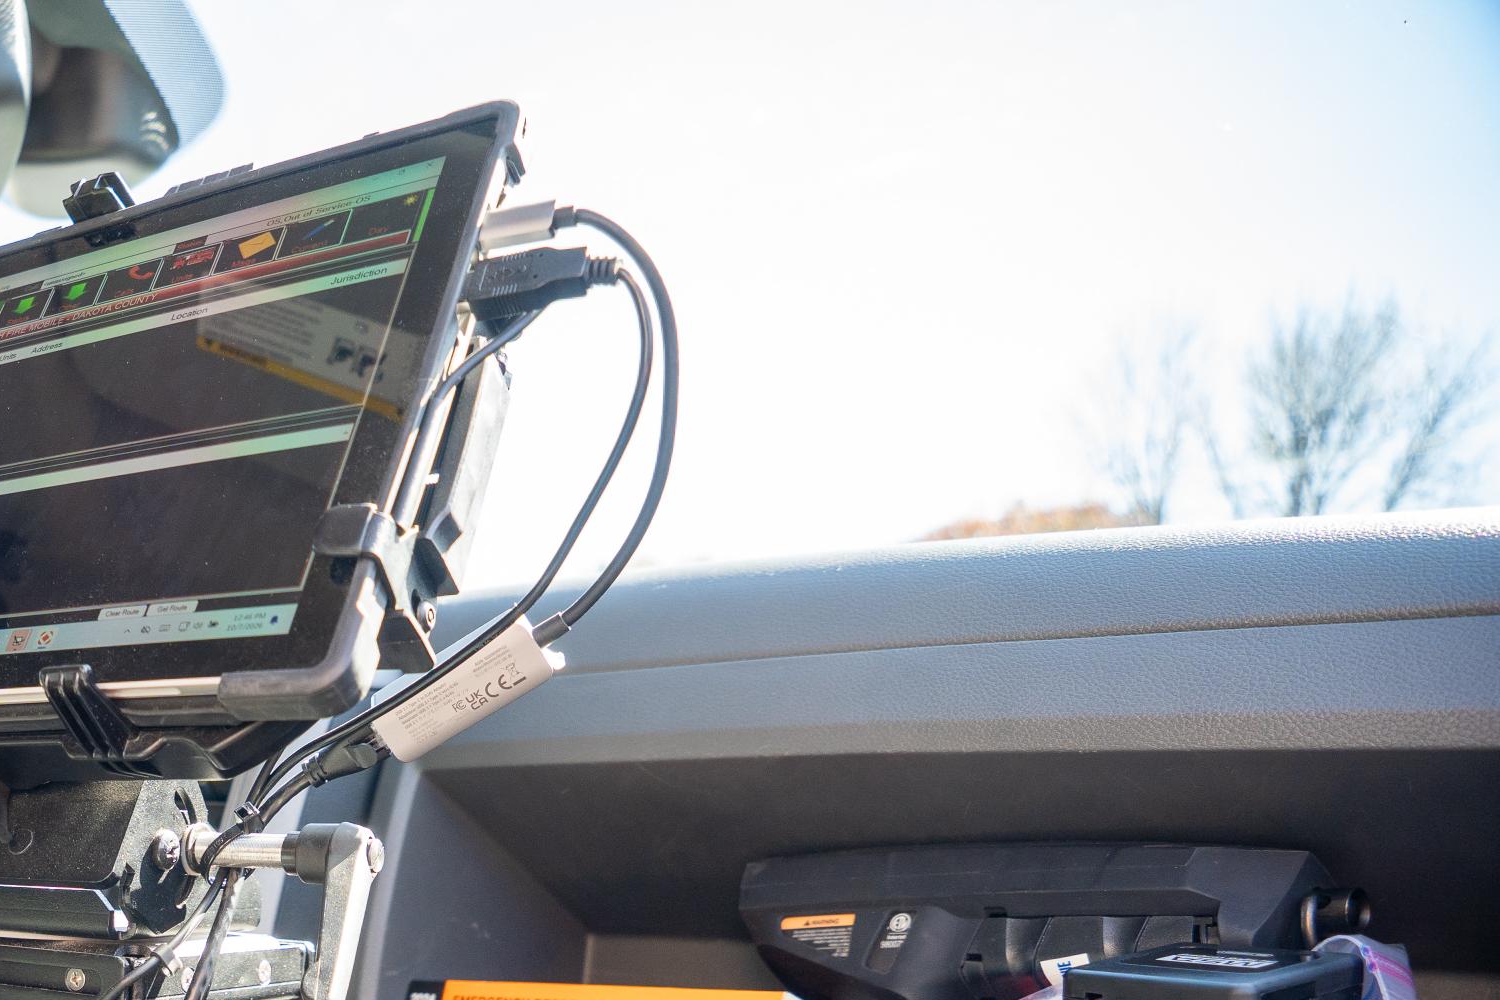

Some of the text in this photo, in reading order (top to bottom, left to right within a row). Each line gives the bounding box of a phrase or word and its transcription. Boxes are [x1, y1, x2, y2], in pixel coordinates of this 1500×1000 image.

[331, 267, 388, 285] Jurisdiction
[6, 326, 28, 340] FIRE
[28, 317, 64, 334] MOBILE
[73, 305, 113, 321] DAKOTA
[114, 293, 160, 310] COUNTY
[0, 352, 18, 364] Units
[30, 341, 63, 354] Address
[170, 307, 209, 321] Location
[123, 608, 140, 616] Route
[171, 604, 188, 612] Route
[485, 674, 512, 697] CE
